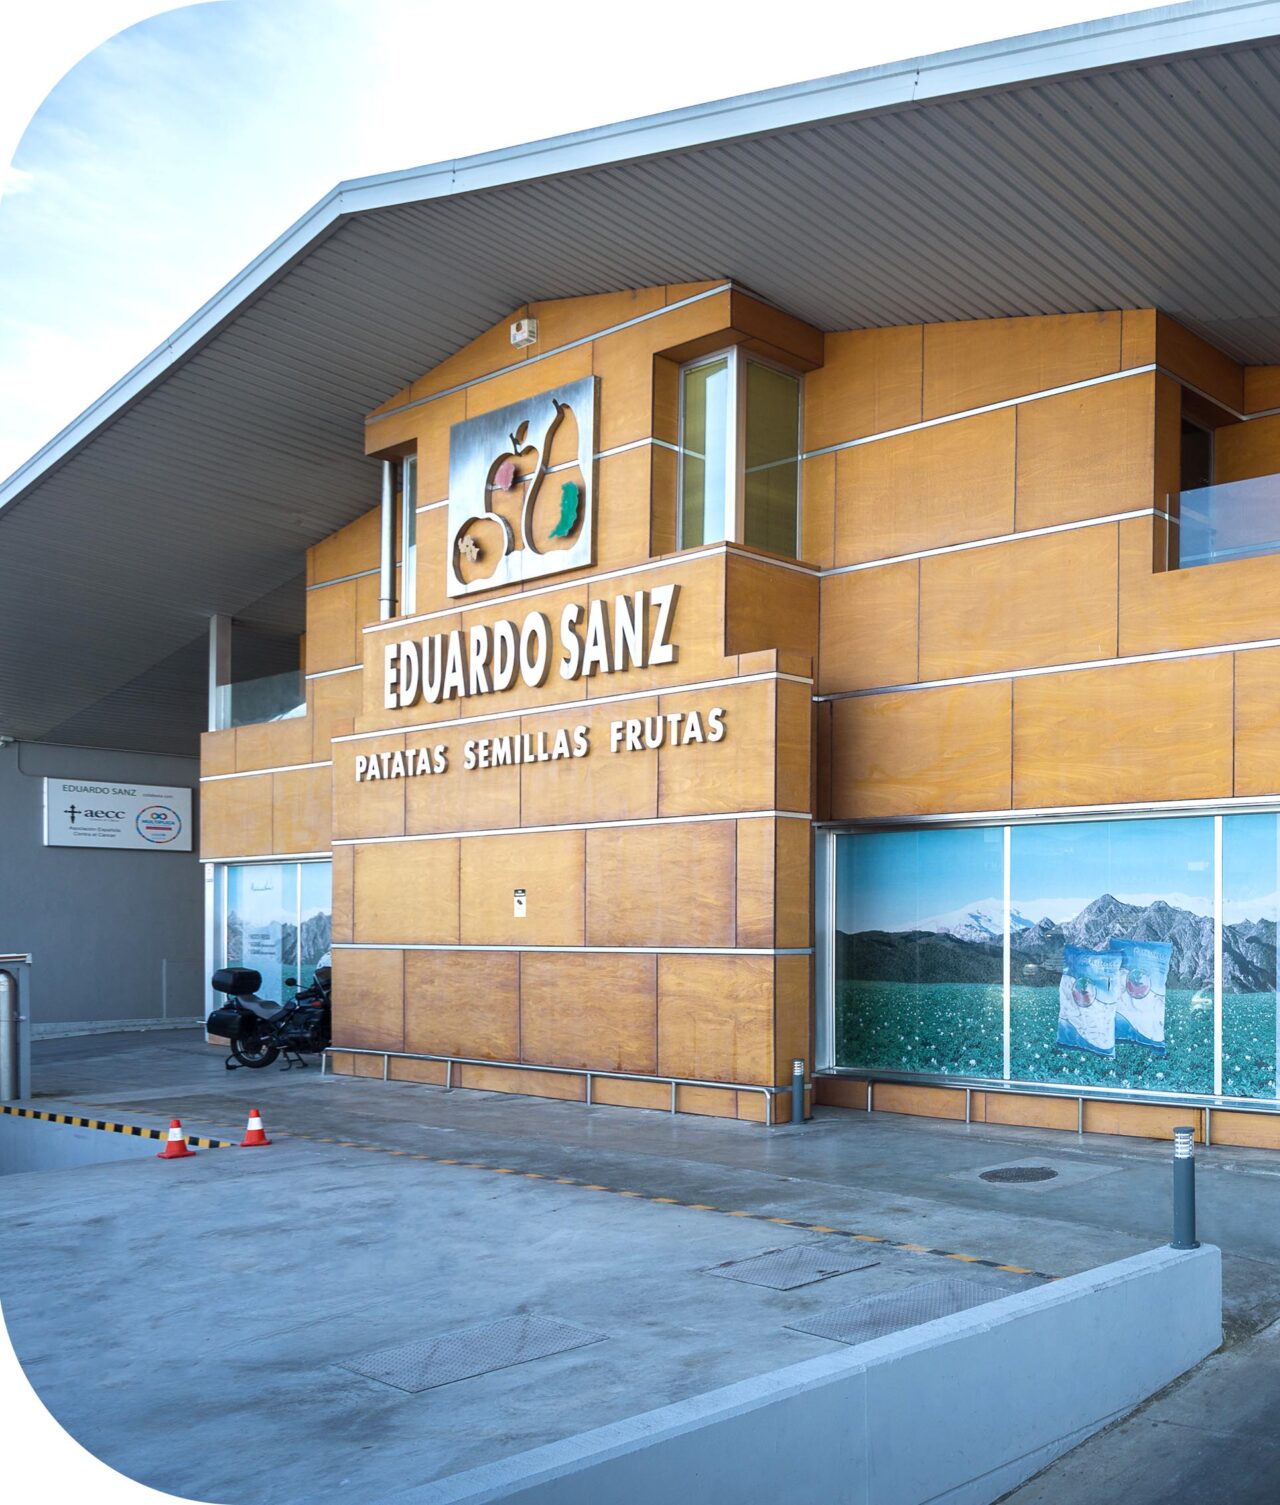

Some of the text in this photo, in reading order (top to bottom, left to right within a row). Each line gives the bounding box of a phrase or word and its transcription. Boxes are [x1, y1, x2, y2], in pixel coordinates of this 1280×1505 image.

[384, 583, 681, 710] EDUARDO SANZ
[355, 707, 727, 782] PATATAS SEMILLAS FRUTAS
[62, 784, 110, 795] EDUARDO
[112, 788, 137, 797] SANZ
[84, 809, 126, 820] aecc
